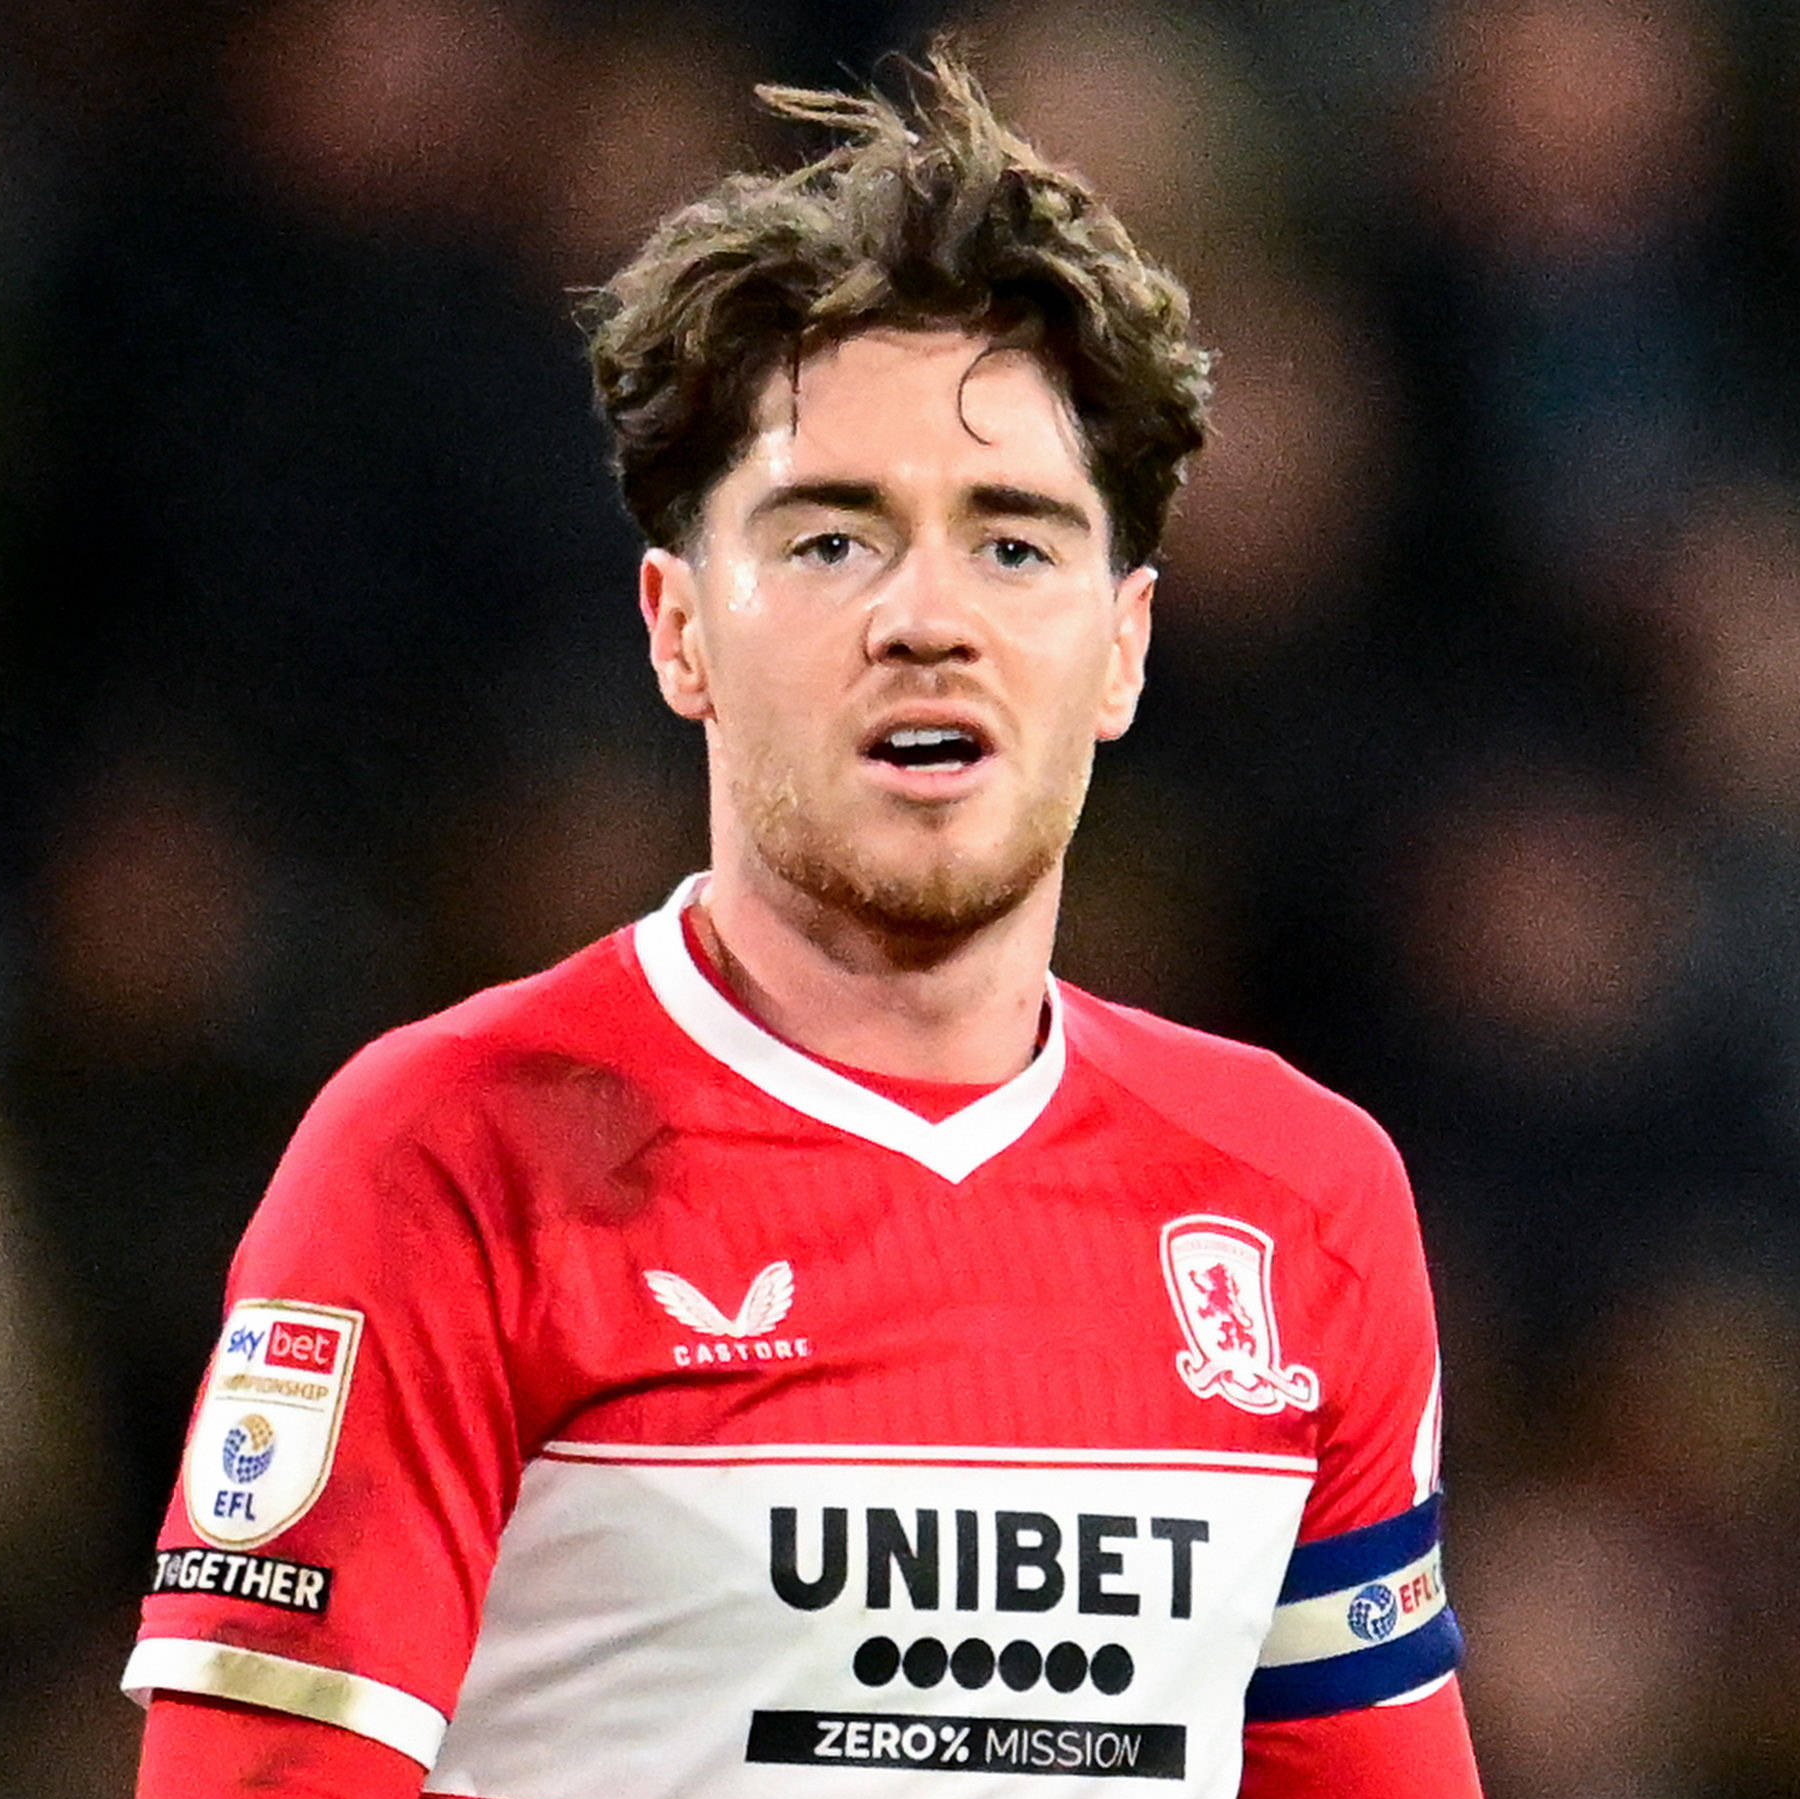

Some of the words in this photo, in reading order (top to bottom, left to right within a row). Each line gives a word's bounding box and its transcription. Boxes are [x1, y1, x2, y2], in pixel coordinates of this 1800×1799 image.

[227, 1325, 265, 1362] sky
[273, 1324, 331, 1365] bet
[672, 1338, 812, 1367] CASTORE
[222, 1373, 330, 1401] IONSHIP
[213, 1490, 256, 1522] EFL
[152, 1549, 324, 1609] TOGETHER
[770, 1506, 1210, 1620] UNIBET
[1399, 1572, 1433, 1615] EFL
[813, 1719, 970, 1764] ZERO%
[984, 1727, 1142, 1769] MISSION
